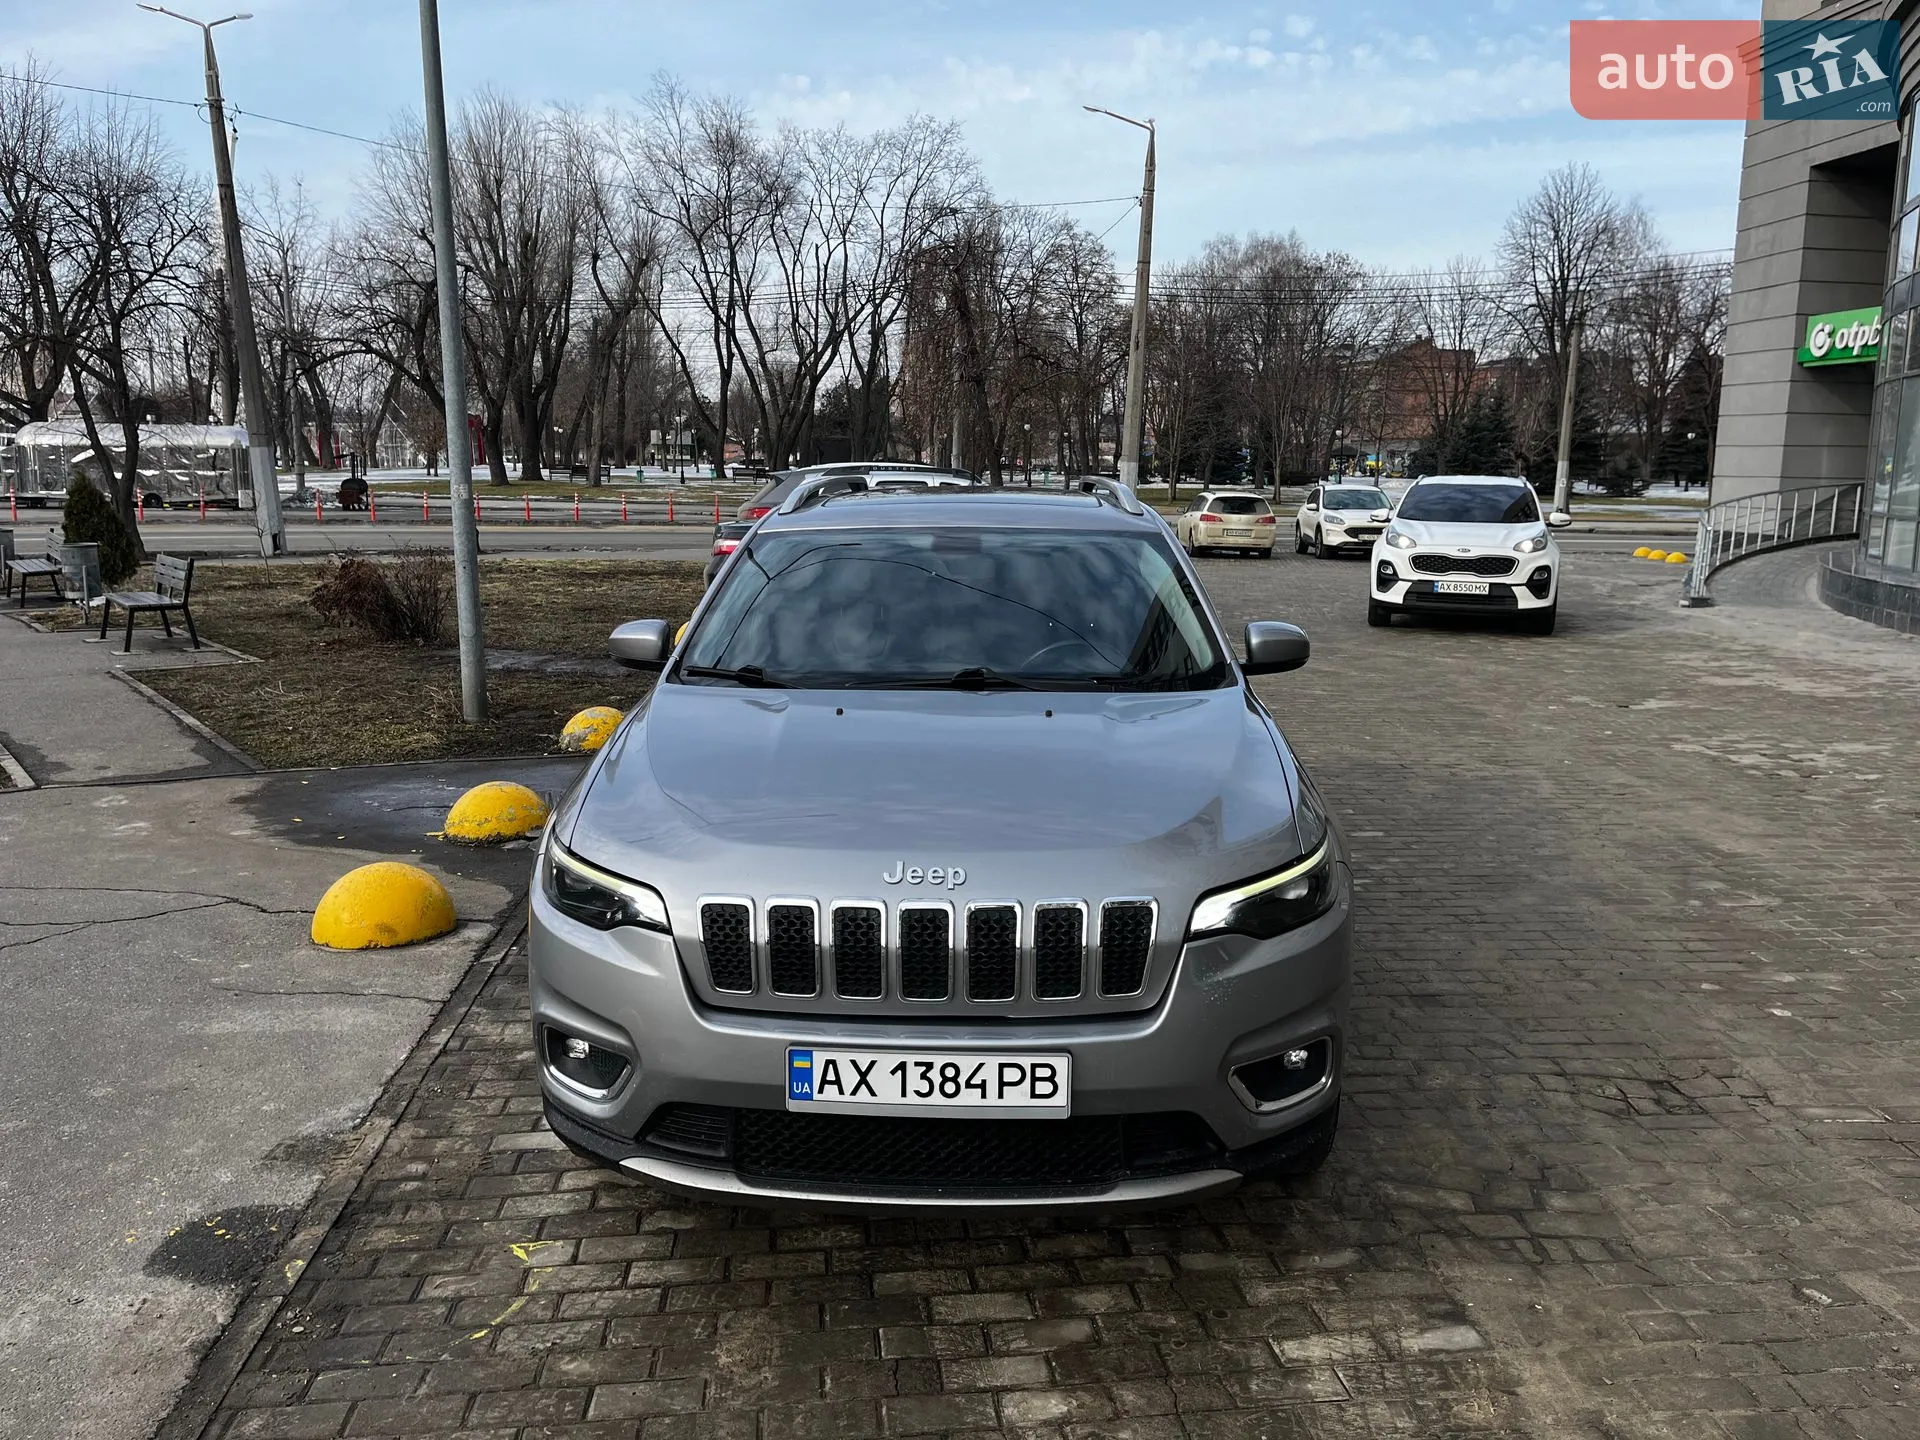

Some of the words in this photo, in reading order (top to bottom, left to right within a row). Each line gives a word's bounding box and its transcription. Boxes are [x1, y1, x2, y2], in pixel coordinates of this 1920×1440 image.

[1440, 583, 1452, 592] AX
[1453, 583, 1474, 593] 8550
[1475, 584, 1488, 593] MX
[883, 861, 967, 890] Jeep
[793, 1082, 811, 1094] UA
[817, 1058, 878, 1097] AX
[889, 1060, 987, 1099] 1384
[998, 1062, 1059, 1100] PB
